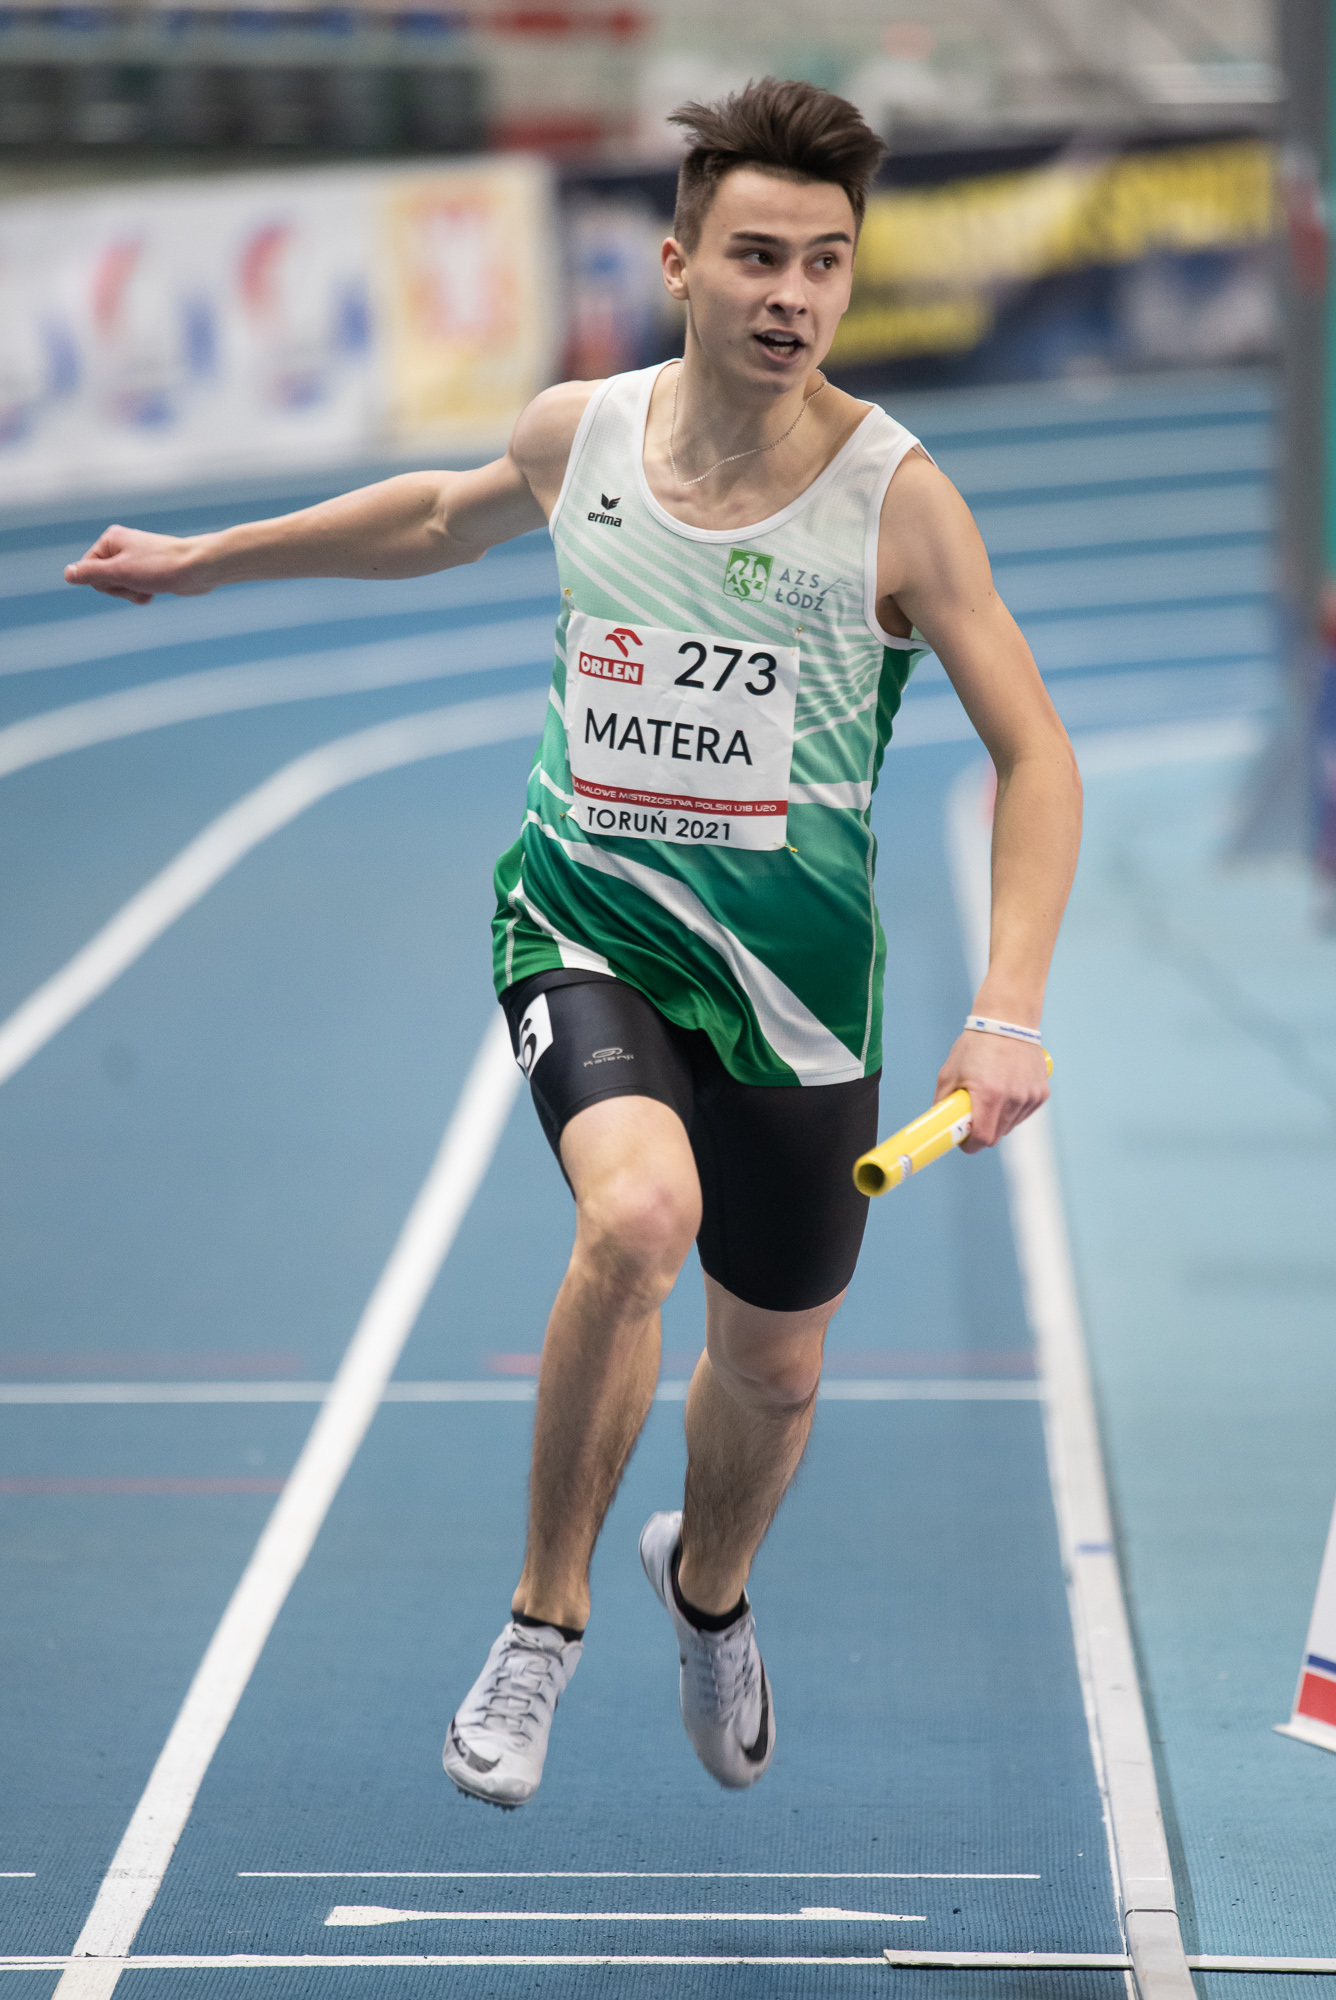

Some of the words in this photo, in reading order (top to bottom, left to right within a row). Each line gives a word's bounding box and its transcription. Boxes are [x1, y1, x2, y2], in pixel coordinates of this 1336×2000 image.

[587, 512, 622, 527] erima
[779, 568, 820, 588] AZS
[580, 655, 639, 682] ORLEN
[674, 641, 777, 696] 273
[584, 707, 753, 766] MATERA
[580, 784, 616, 798] HALOWE
[619, 792, 693, 808] MISTRZOSTWA
[695, 801, 732, 812] POLSKI
[734, 804, 753, 812] U18
[587, 806, 667, 835] TORUŃ
[675, 818, 730, 840] 2021
